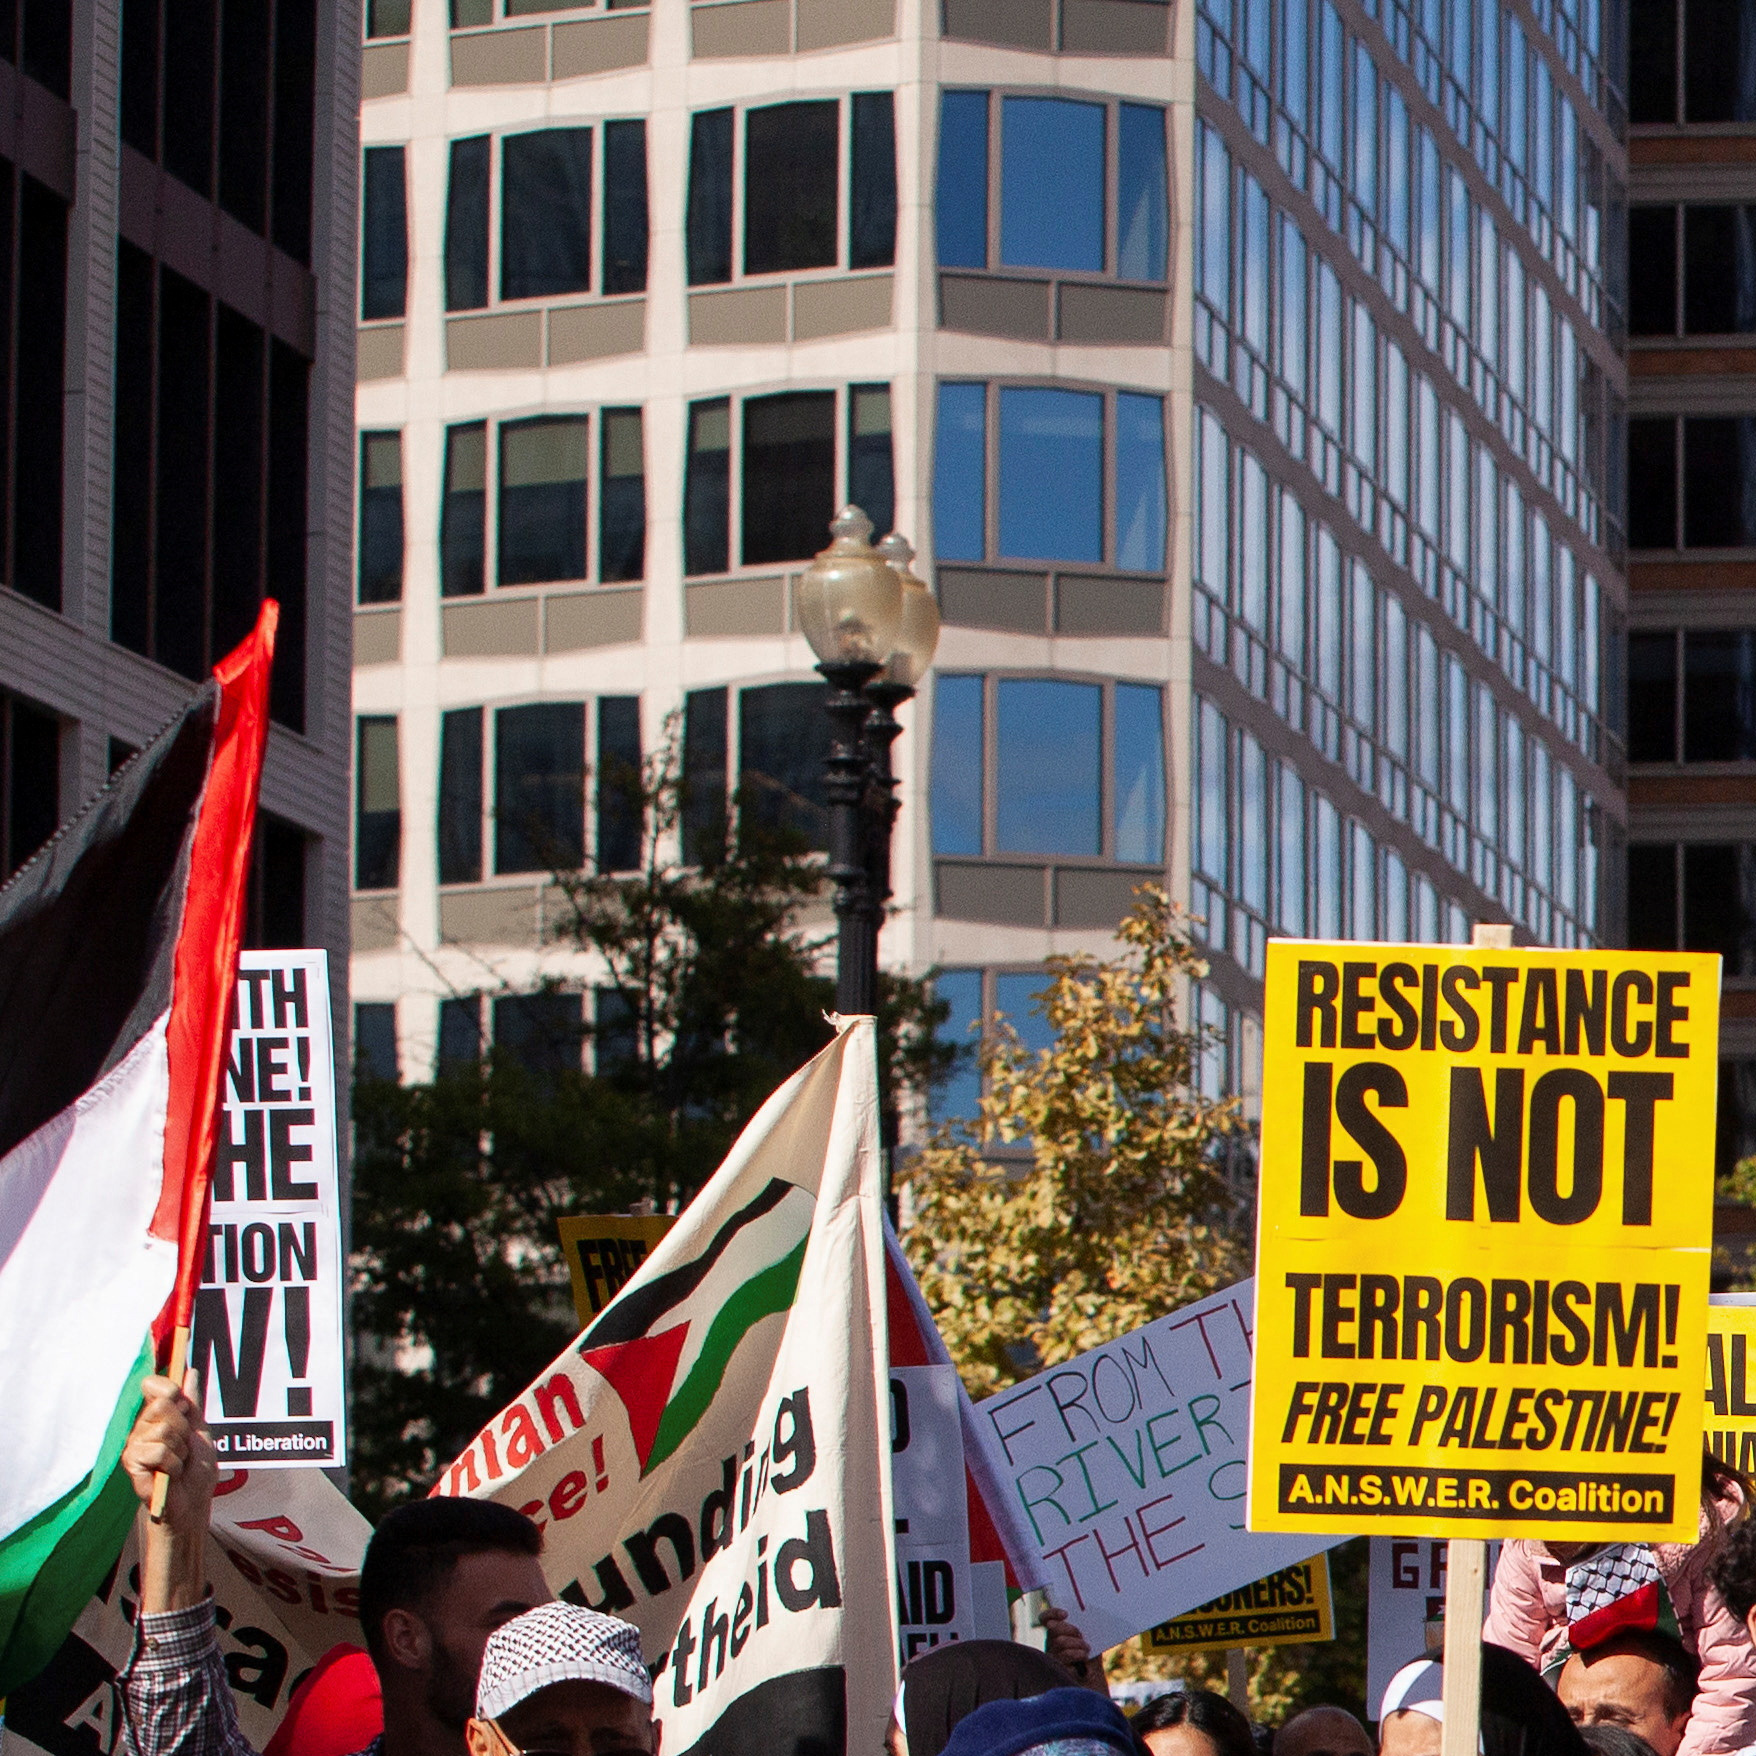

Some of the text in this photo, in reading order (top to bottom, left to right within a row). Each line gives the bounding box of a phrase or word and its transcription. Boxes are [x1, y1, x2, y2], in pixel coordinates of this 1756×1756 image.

[1295, 959, 1691, 1059] RESISTANCE
[1299, 1061, 1675, 1228] IS NOT
[1285, 1271, 1681, 1369] TERRORISM!
[234, 1433, 328, 1452] Liberation
[988, 1337, 1175, 1467] FROM
[1280, 1381, 1681, 1455] FREE PALESTINE!
[1016, 1394, 1234, 1547] RIVER
[1288, 1472, 1500, 1511] A.N.S.W.E.R.
[1508, 1478, 1665, 1515] Coalition
[1042, 1494, 1206, 1612] THE
[648, 1507, 842, 1710] theid
[1155, 1615, 1316, 1642] A.N.S.W.E.R. Coalition
